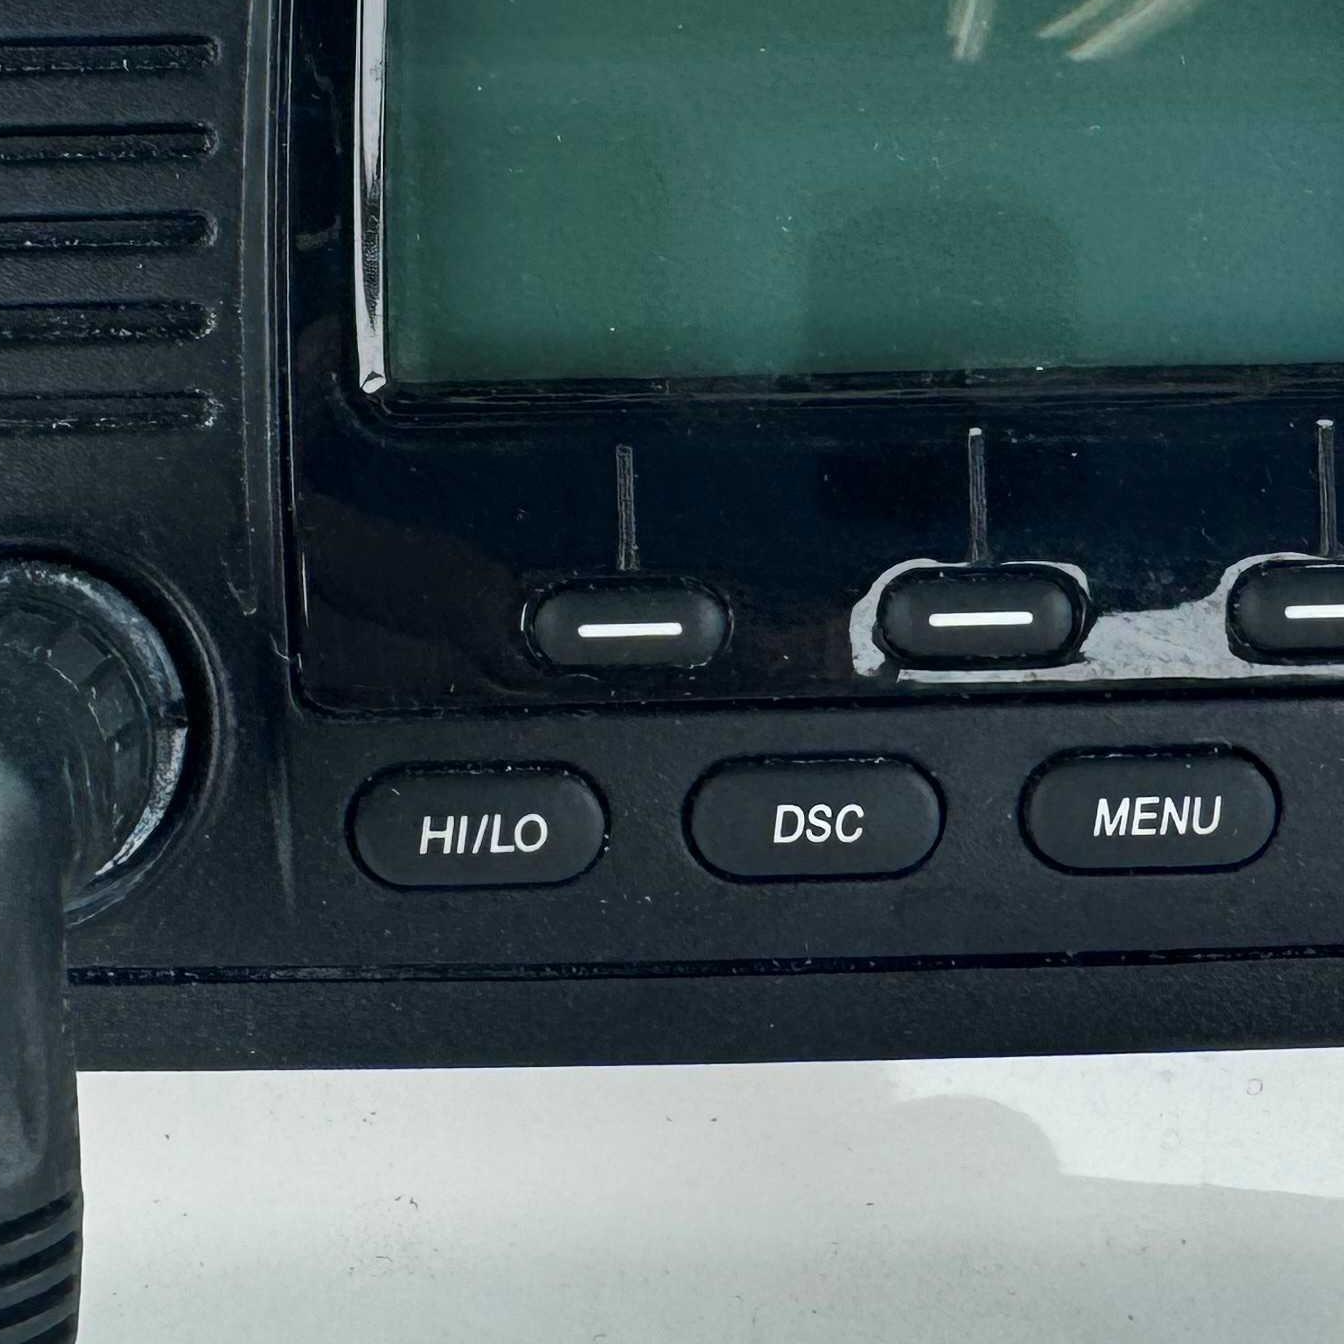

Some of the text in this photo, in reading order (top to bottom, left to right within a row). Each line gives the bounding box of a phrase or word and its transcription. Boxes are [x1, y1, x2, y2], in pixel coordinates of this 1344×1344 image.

[419, 813, 548, 854] HI/LO
[773, 803, 865, 844] DSC
[1093, 795, 1223, 837] MENU
